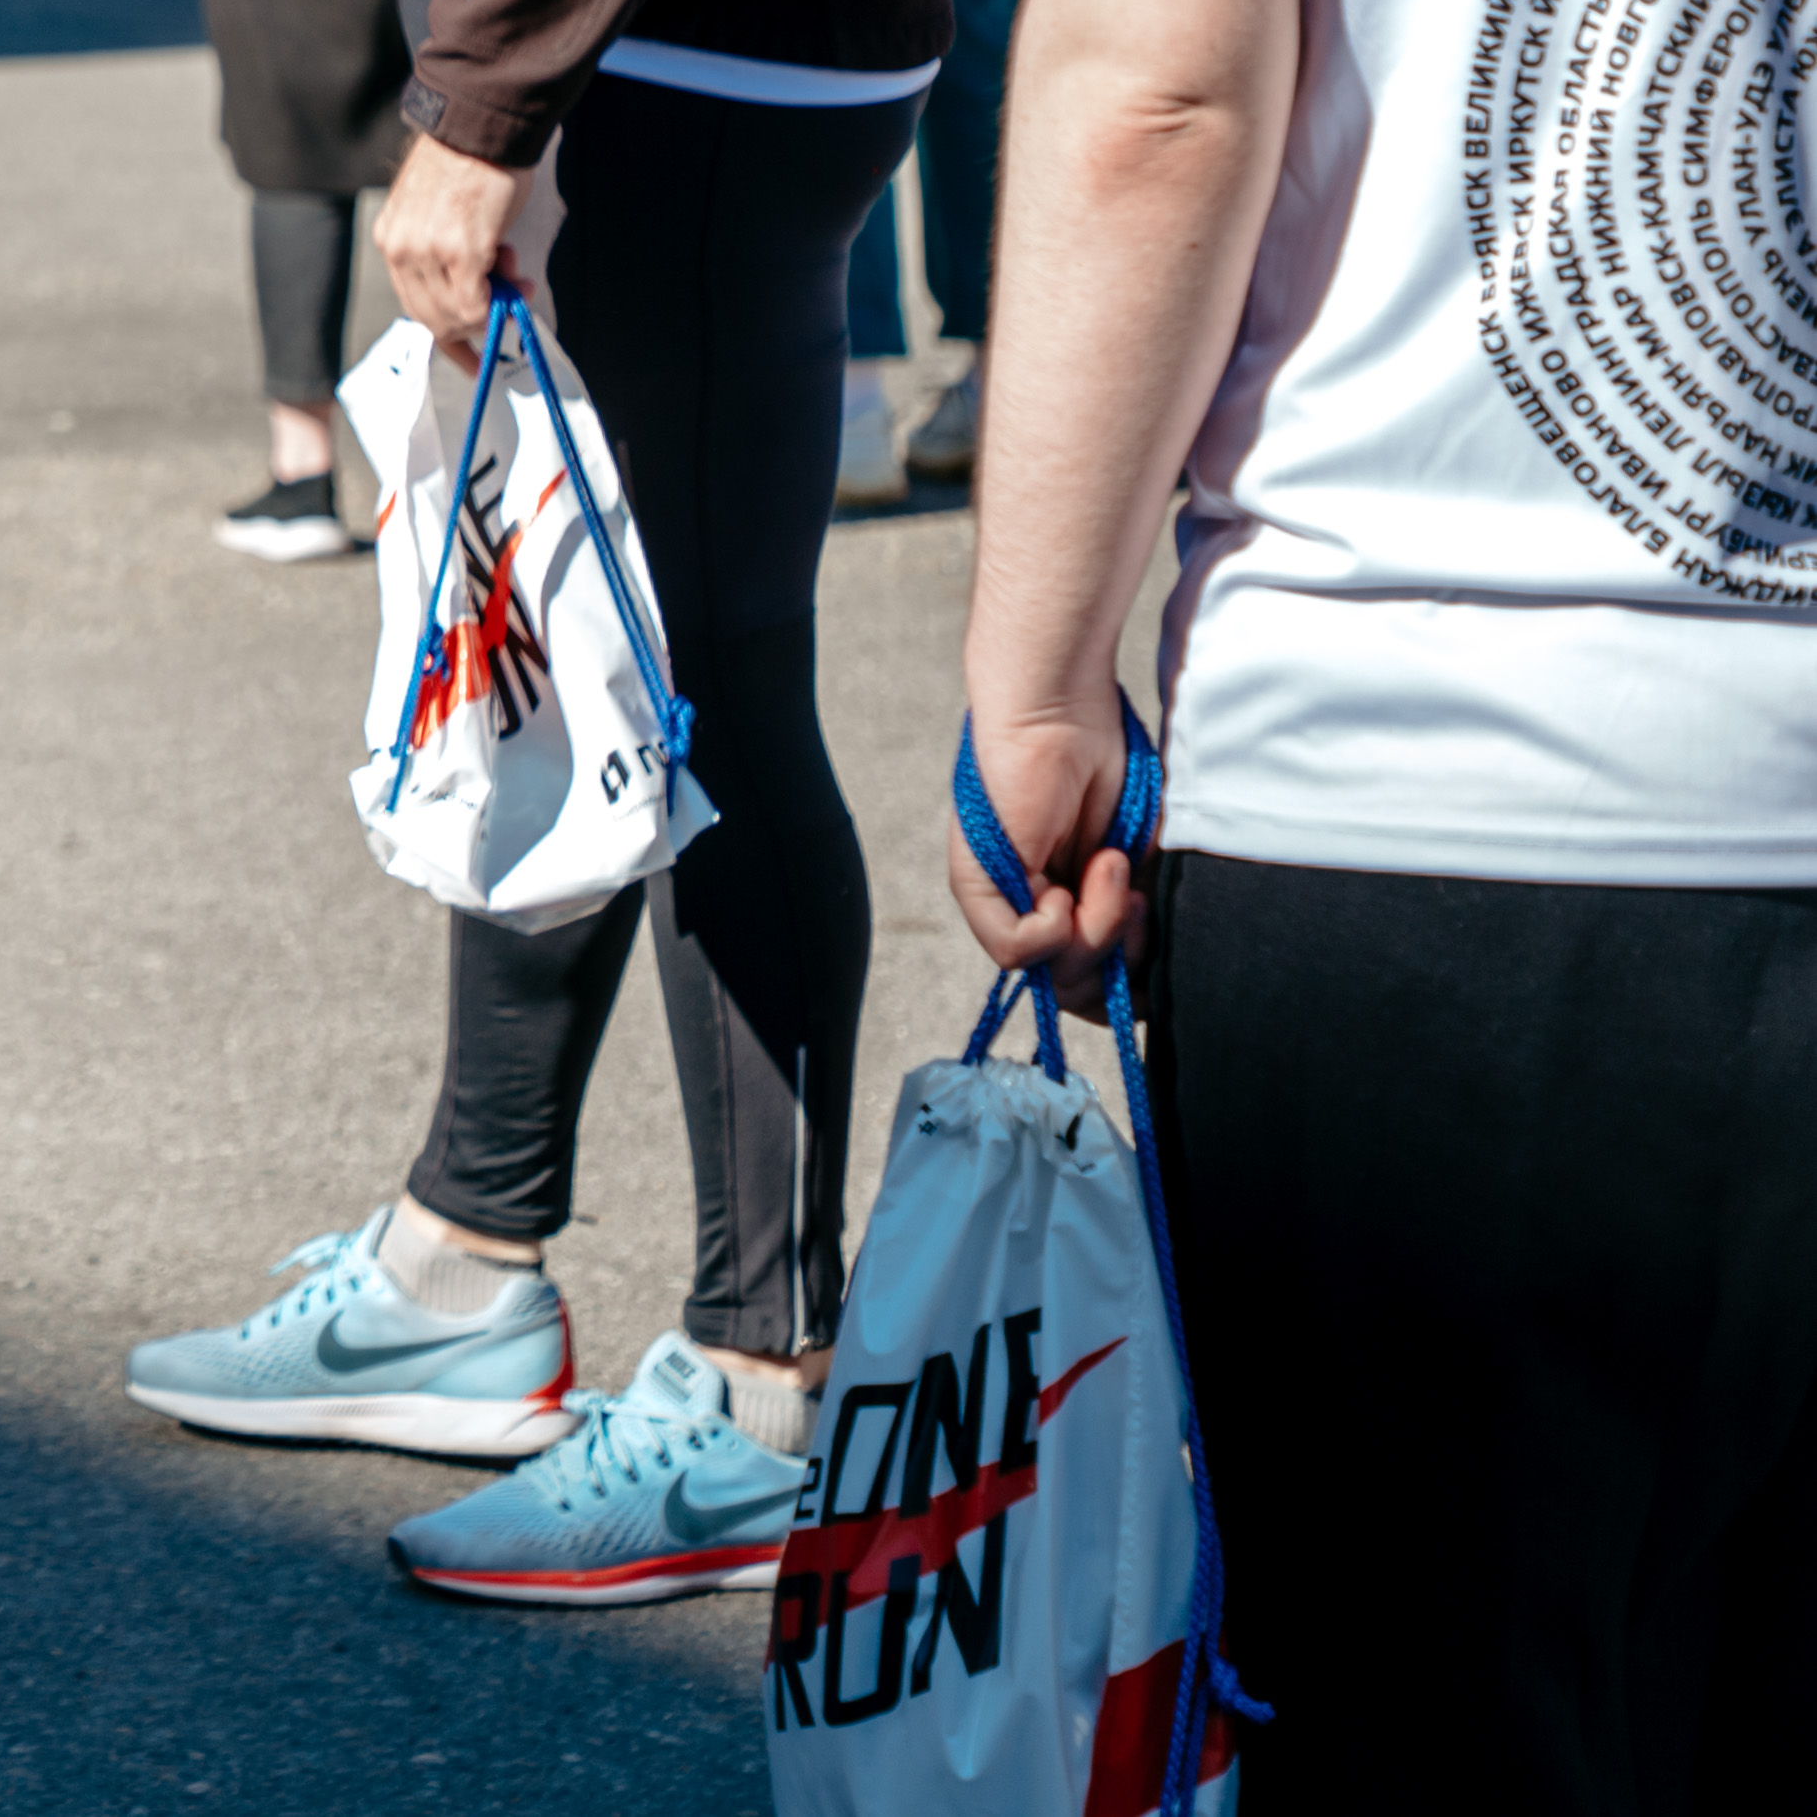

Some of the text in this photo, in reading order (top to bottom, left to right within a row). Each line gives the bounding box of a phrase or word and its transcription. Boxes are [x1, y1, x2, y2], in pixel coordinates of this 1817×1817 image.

[1509, 24, 1552, 185] ИРКУТСК
[1732, 59, 1776, 247] УЛАН-УДЭ
[1773, 88, 1805, 234] ЭЛИСТА
[1465, 168, 1499, 304] БРЯНСК
[1510, 195, 1554, 344] ИЖЕВСК
[1586, 108, 1630, 276] НИЖНИЙ
[1548, 168, 1696, 454] ЛЕНИНГРАДСКАЯ
[1612, 286, 1783, 468] НАРЬЯН-МАР
[1478, 310, 1671, 557] БЛАГОВЕЩЕНСК
[1540, 349, 1671, 500] ИВАНОВО
[1690, 448, 1801, 524] КЫЗЫЛ
